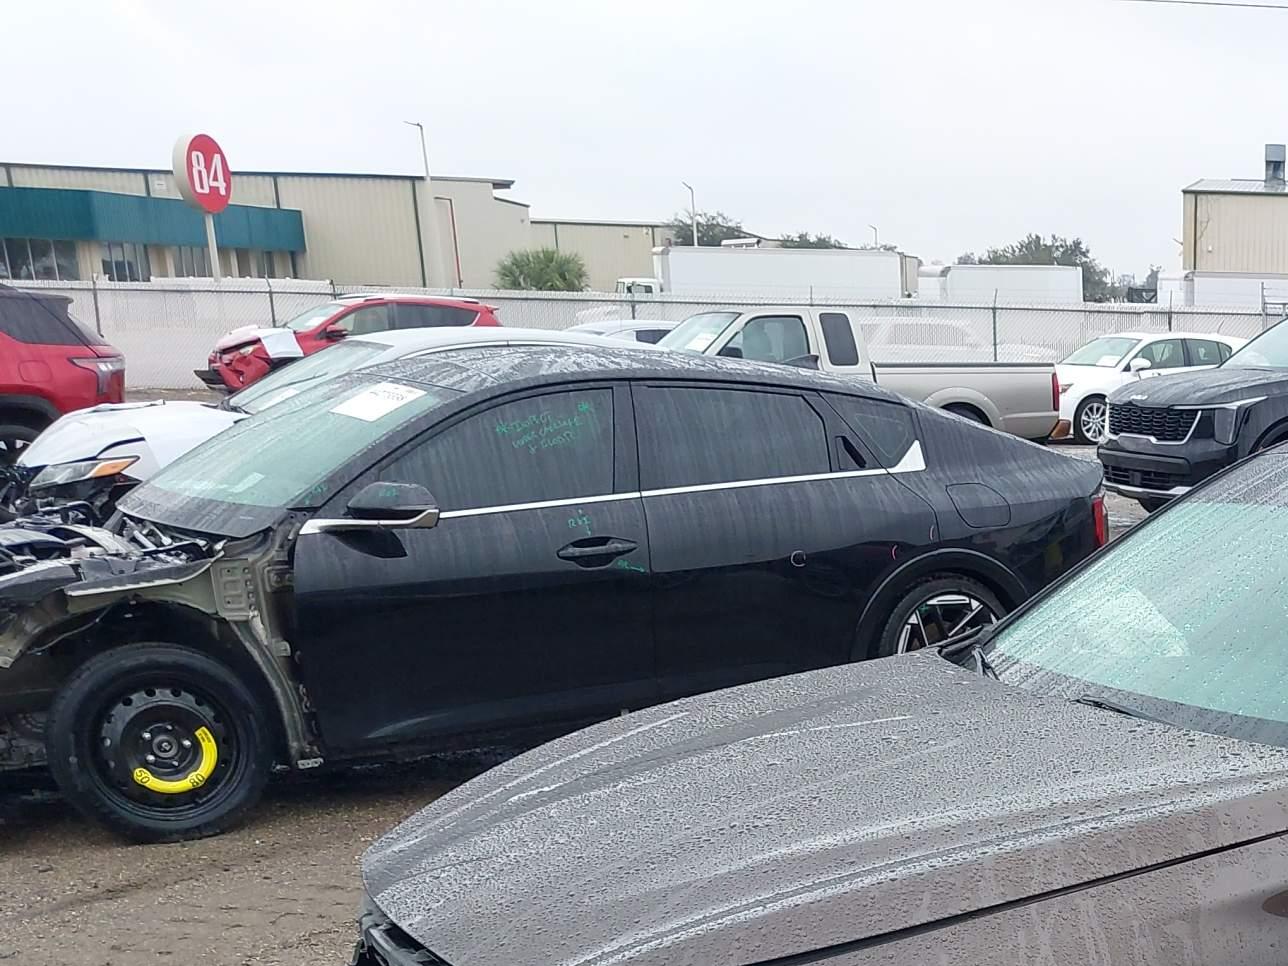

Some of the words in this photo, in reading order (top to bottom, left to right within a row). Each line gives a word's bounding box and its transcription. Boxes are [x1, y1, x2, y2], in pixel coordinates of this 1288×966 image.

[191, 150, 227, 196] 84
[136, 769, 150, 784] 50
[190, 773, 205, 787] 80
